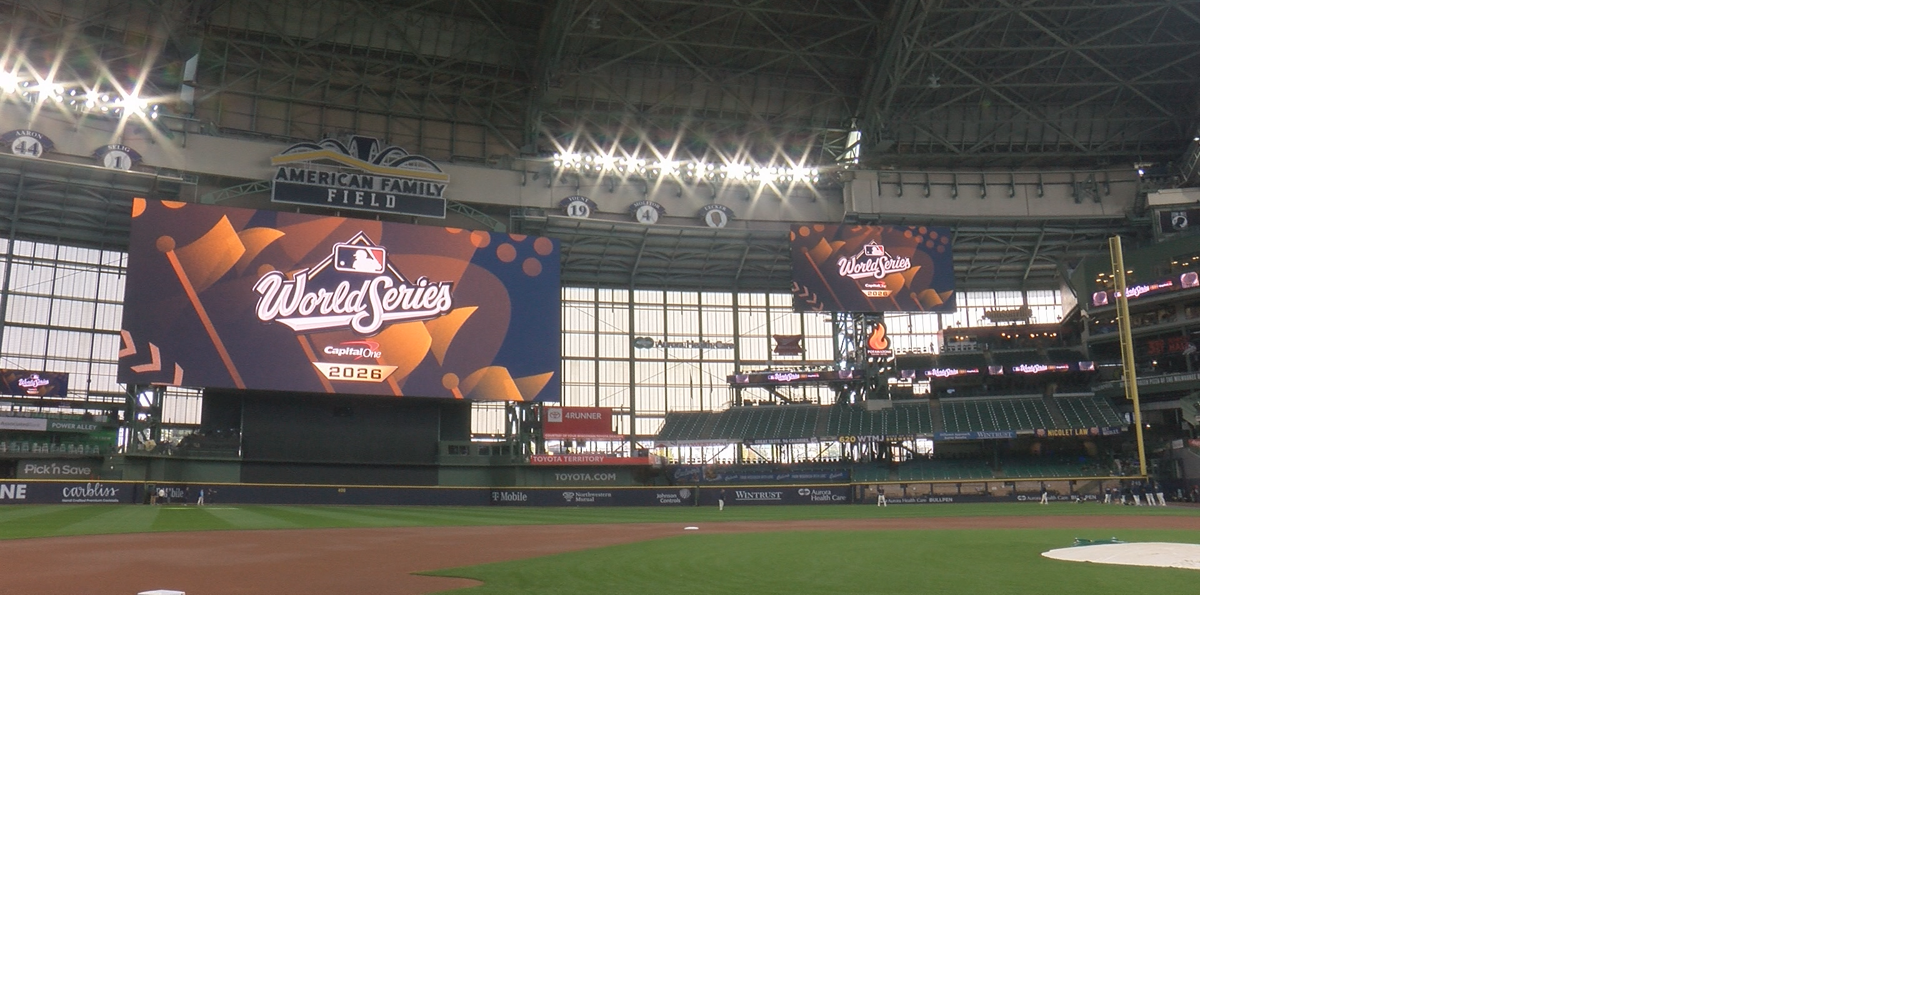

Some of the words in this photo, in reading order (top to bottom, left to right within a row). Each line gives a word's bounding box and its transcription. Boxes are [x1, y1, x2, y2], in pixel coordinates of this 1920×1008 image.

[15, 141, 39, 156] 44
[107, 144, 131, 152] SELIG
[114, 156, 122, 169] 1
[276, 167, 374, 190] AMERICAN
[381, 178, 446, 198] FAMILY
[327, 188, 396, 208] FIELD
[570, 204, 586, 216] 19
[641, 210, 650, 222] 4
[838, 255, 879, 276] World
[873, 255, 912, 279] Series
[253, 271, 371, 322] World
[351, 274, 452, 334] Series
[328, 366, 382, 380] 2026
[565, 412, 602, 420] 4RUNNER
[839, 435, 856, 443] 620
[24, 464, 49, 474] Pick
[62, 465, 91, 474] Save
[63, 483, 119, 497] carbliss
[736, 491, 783, 500] WINTRUST
[501, 492, 527, 501] Mobile
